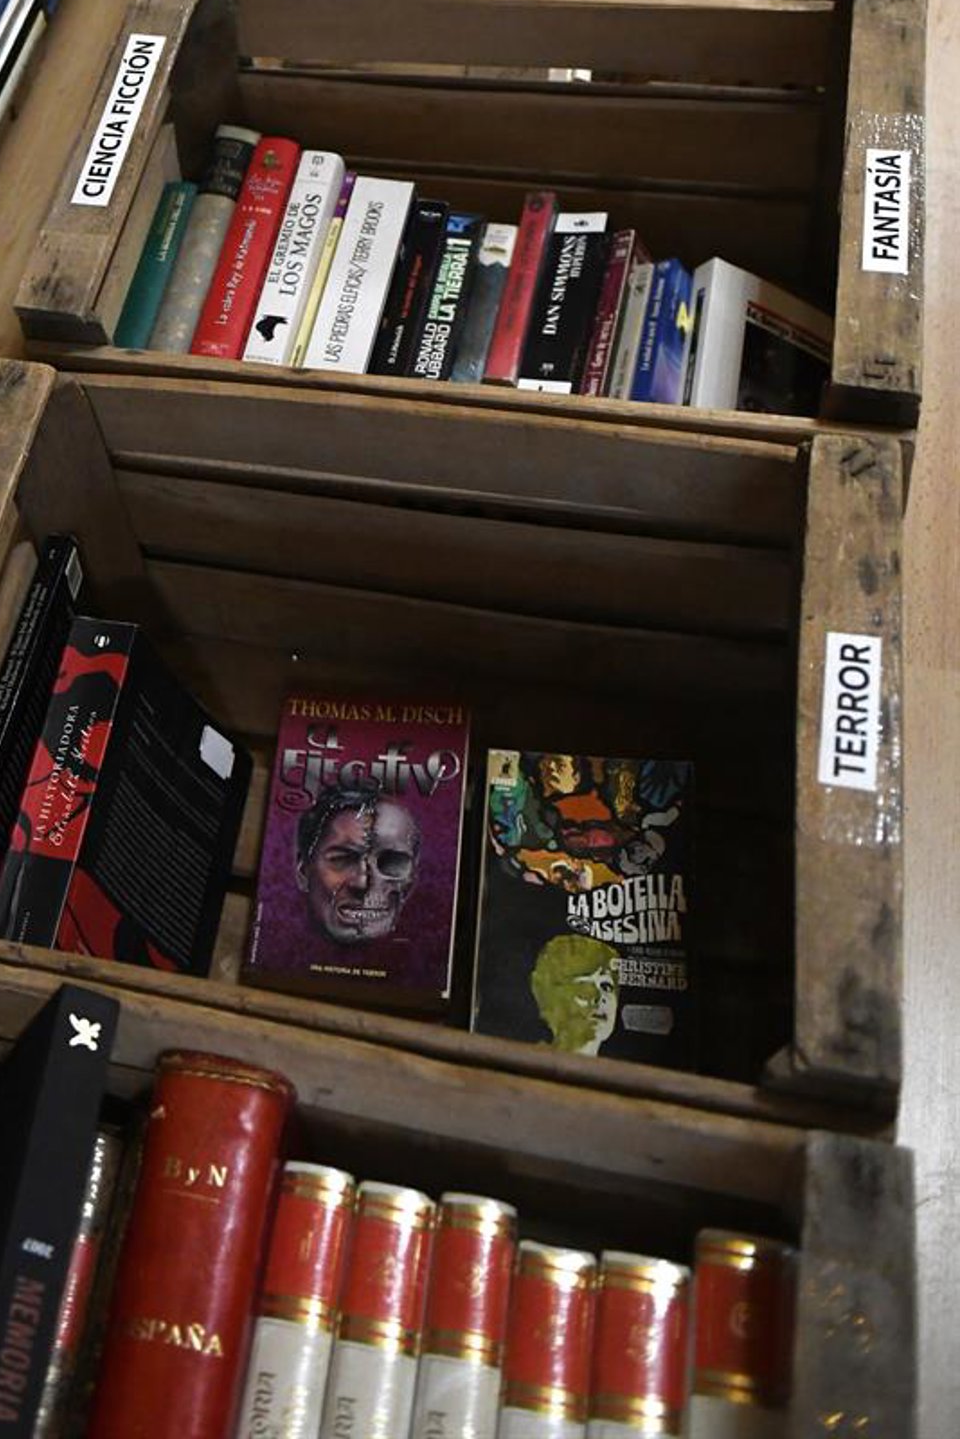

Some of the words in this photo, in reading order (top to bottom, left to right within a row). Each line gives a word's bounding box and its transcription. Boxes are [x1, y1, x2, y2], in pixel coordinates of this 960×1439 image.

[81, 117, 127, 199] CIENCIA
[112, 40, 157, 118] FICCIÓN
[288, 203, 301, 219] DE
[871, 153, 903, 261] FANTASÍA
[272, 220, 295, 270] GREMIO
[279, 258, 303, 296] LOS
[296, 193, 322, 257] MAGOS
[268, 269, 280, 284] EL
[551, 235, 578, 302] SIMMONS
[330, 302, 355, 344] PIEDRAS
[437, 301, 458, 322] LA
[542, 305, 561, 335] DAN
[324, 342, 343, 363] LAS
[415, 322, 438, 375] RONALD
[426, 324, 451, 380] UBBARD
[290, 699, 371, 721] THOMAS
[376, 705, 397, 722] M.
[403, 705, 464, 726] DISCH
[833, 643, 871, 777] TERROR
[38, 702, 80, 820] HISTORIADORA
[32, 820, 46, 842] LA
[568, 893, 590, 918] LA
[592, 874, 687, 919] BOTELLA
[590, 911, 681, 944] ASESINA
[618, 971, 688, 990] BERNARD
[208, 1165, 228, 1188] N
